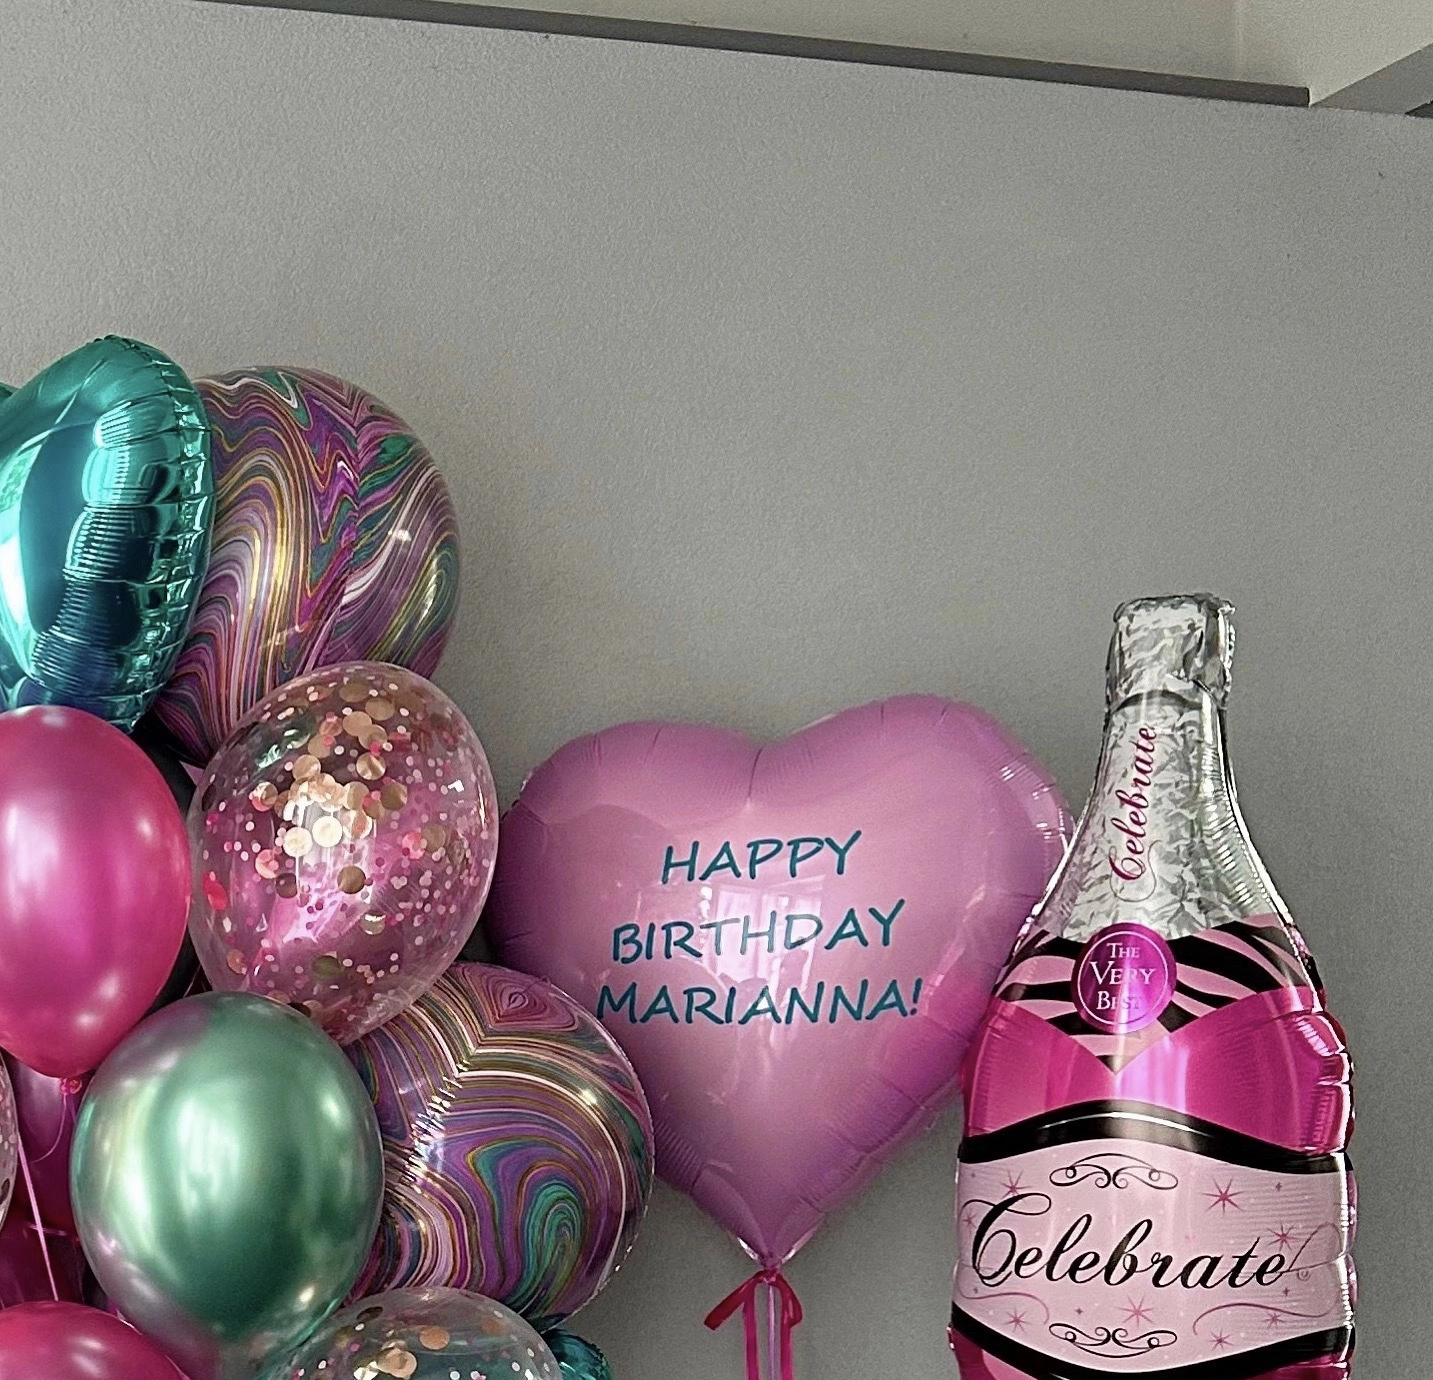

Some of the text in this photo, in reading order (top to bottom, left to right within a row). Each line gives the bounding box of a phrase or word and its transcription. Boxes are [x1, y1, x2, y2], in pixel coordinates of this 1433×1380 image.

[1108, 725, 1158, 886] Celebrate
[660, 829, 863, 885] HAPPY
[611, 898, 906, 965] BIRTHDAY
[1106, 942, 1141, 959] THE
[595, 977, 924, 1026] MARIANNA!
[963, 1192, 1292, 1291] Celebrate
